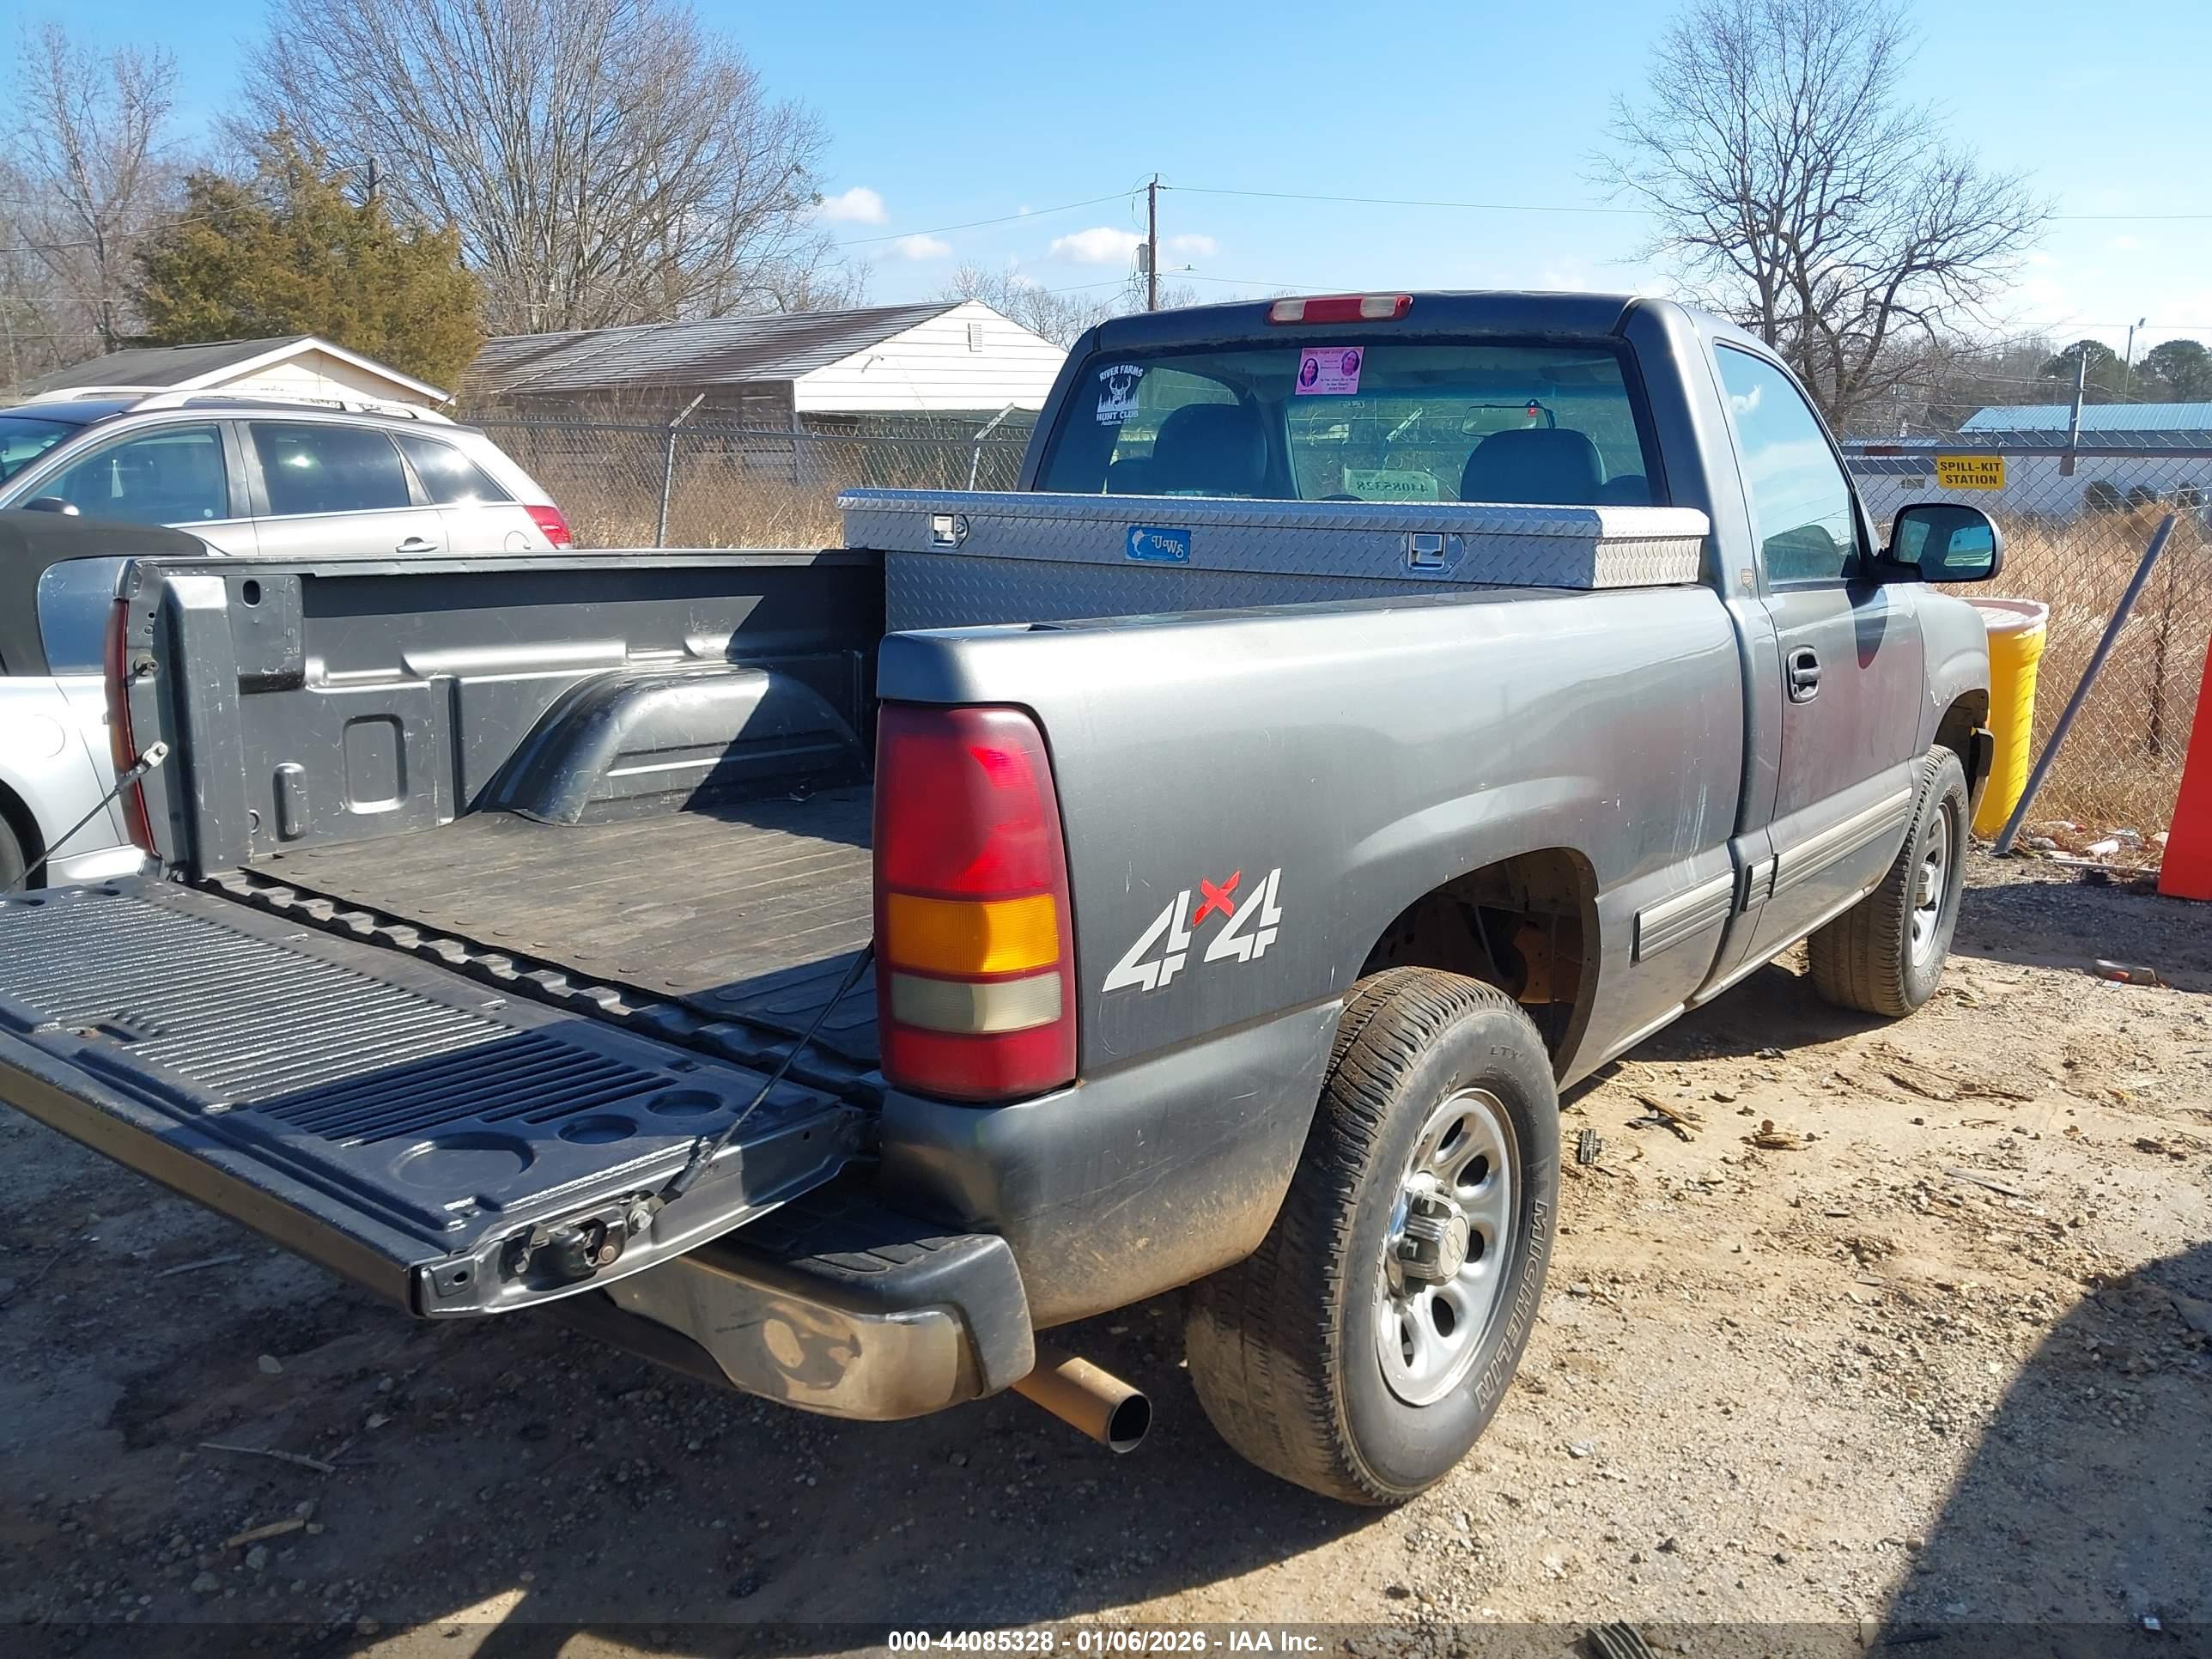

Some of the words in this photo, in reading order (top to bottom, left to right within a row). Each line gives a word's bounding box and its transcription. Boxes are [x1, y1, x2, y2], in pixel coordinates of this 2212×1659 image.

[1099, 366, 1119, 382] RIVER
[1120, 365, 1144, 377] FARMS
[1097, 412, 1117, 421] HUNT
[1120, 410, 1139, 419] CLUB
[1940, 461, 2002, 472] SPILL-KIT
[1945, 474, 1997, 485] STATION
[1151, 535, 1184, 558] UWS
[1474, 1199, 1548, 1413] MICHELIN
